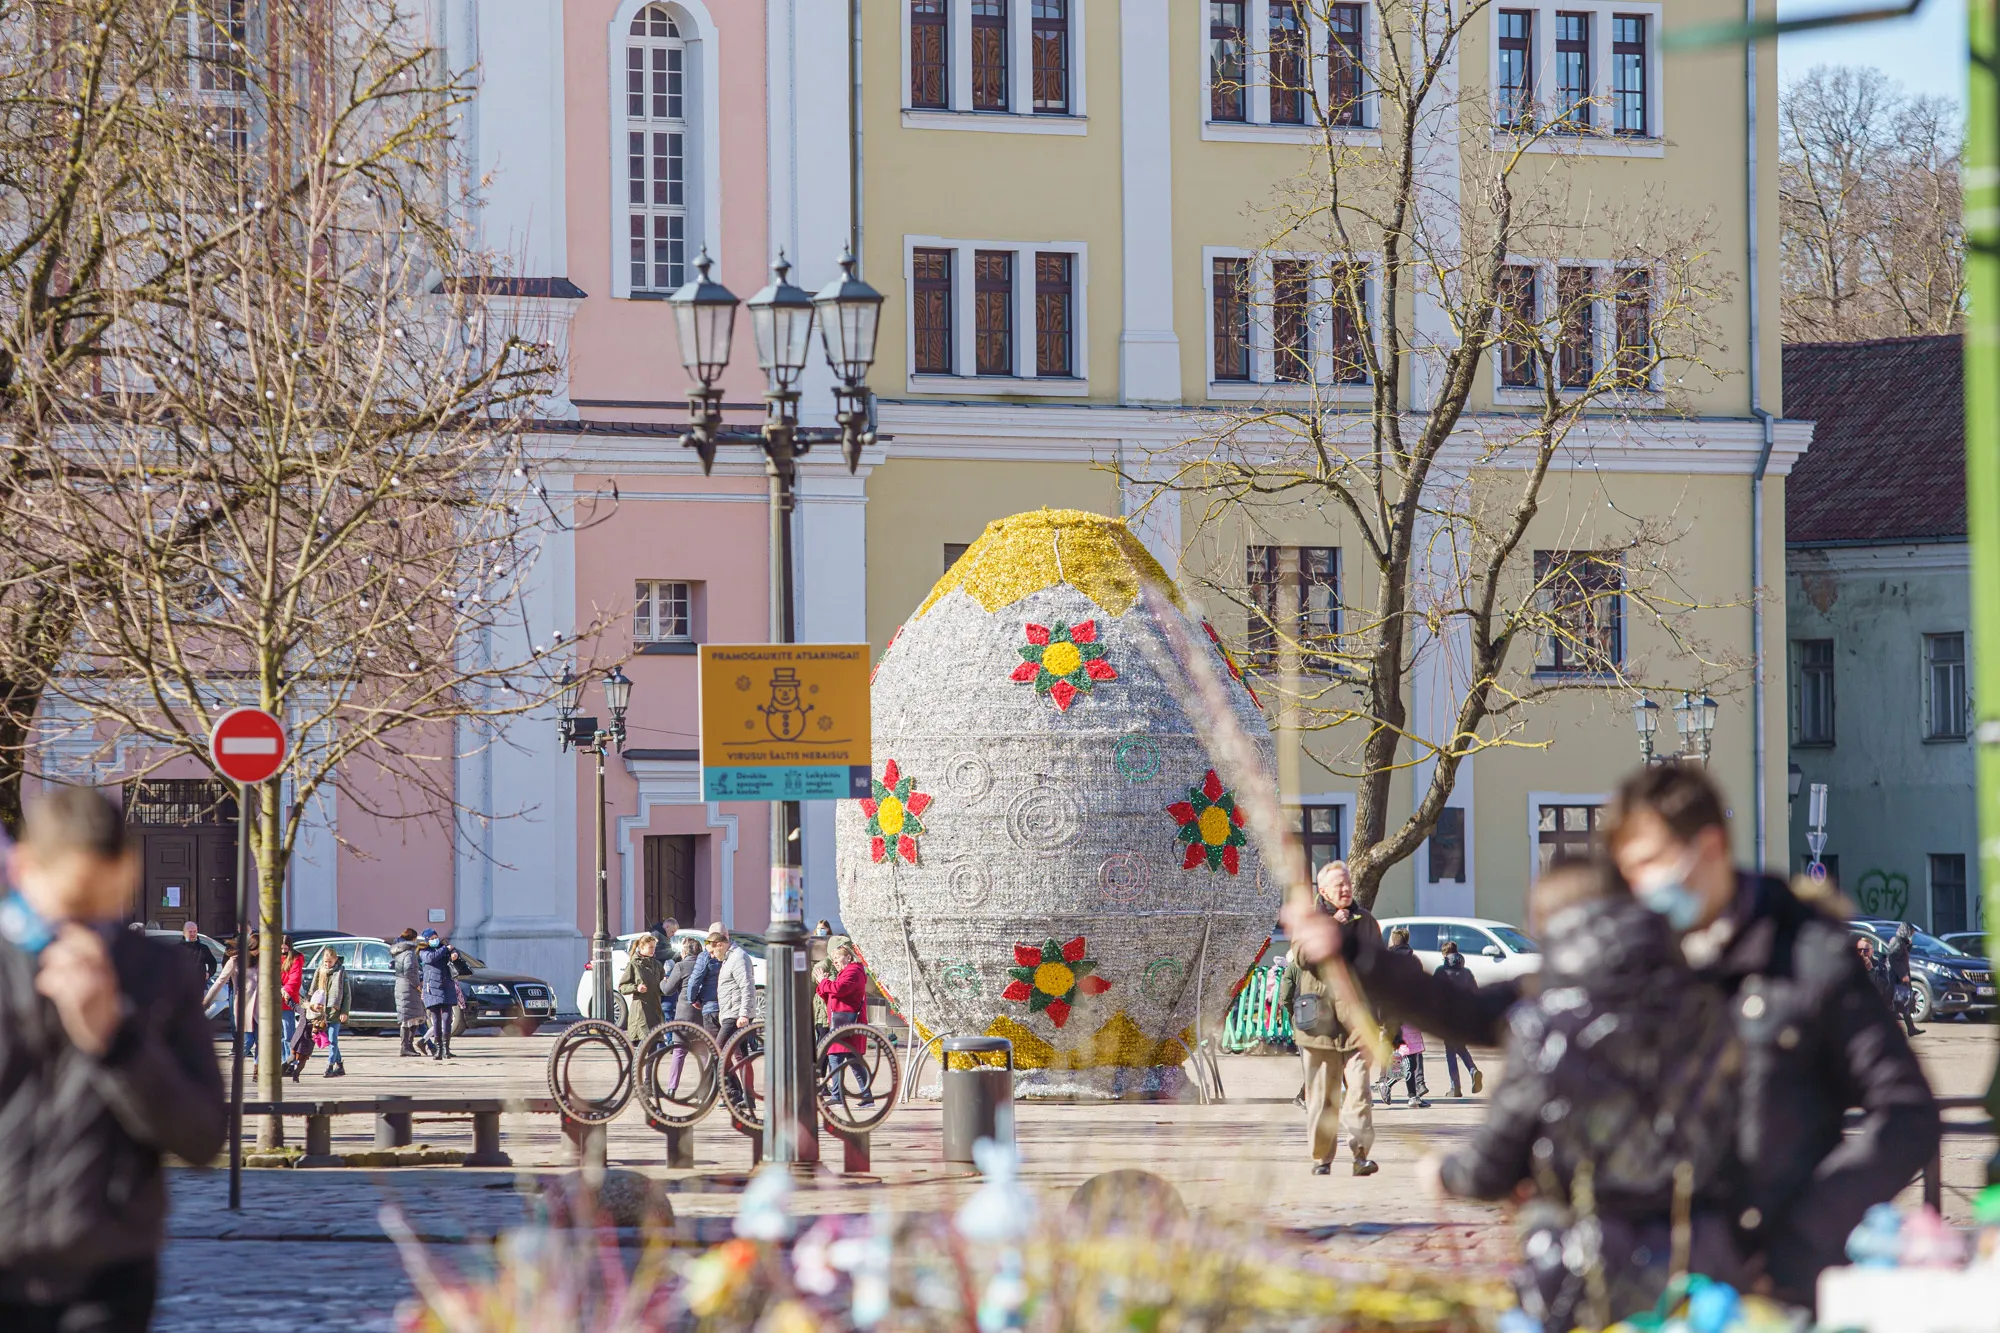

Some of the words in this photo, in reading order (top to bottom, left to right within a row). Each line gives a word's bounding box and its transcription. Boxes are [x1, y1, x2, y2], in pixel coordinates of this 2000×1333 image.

[711, 652, 793, 661] PRAMOGAUKITE
[795, 651, 860, 660] ATSAKINGAI!
[727, 751, 767, 760] VIRUSUI
[769, 750, 800, 760] ŠALTIS
[802, 751, 849, 760] NEBAISUS
